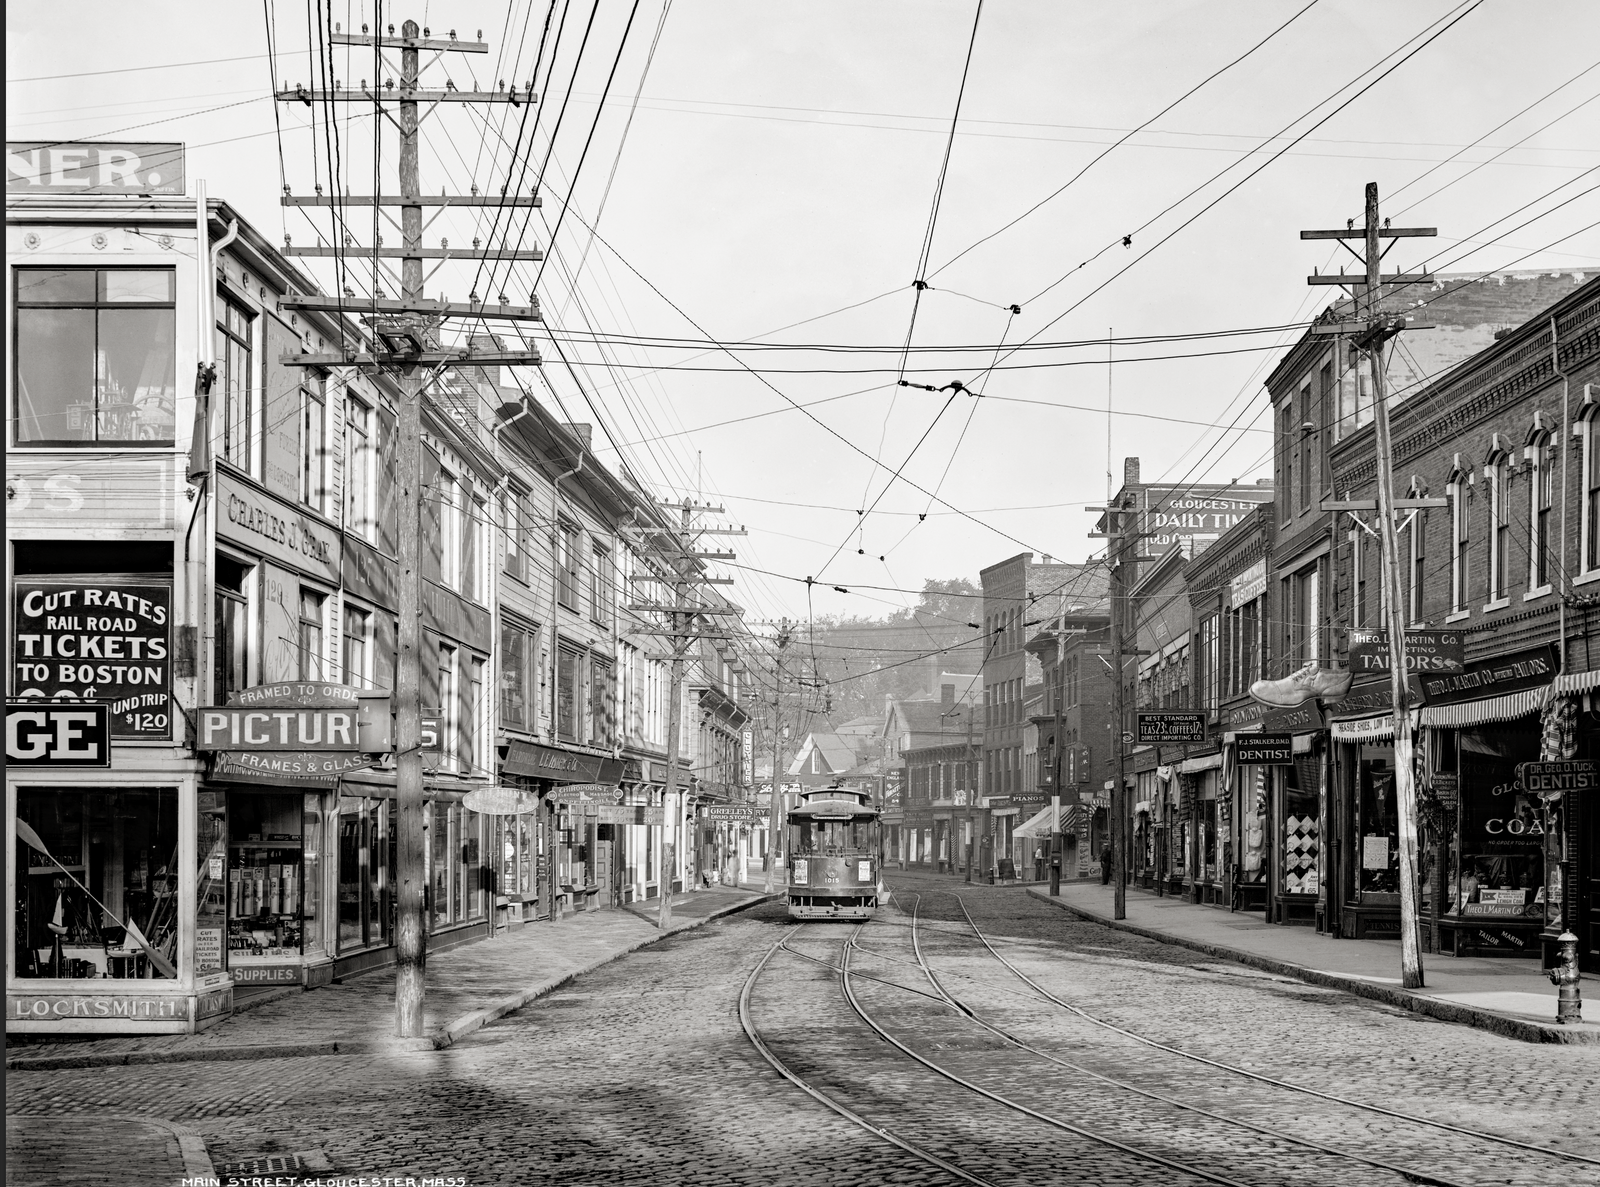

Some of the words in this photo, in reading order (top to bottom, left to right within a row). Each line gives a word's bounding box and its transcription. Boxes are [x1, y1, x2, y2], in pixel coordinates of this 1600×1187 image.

[227, 493, 286, 546] CHARLES
[301, 528, 331, 565] GRAY.
[1155, 513, 1208, 528] DAILY
[1211, 513, 1247, 529] TIM
[23, 589, 77, 617] CUT
[84, 589, 167, 625] RATES
[46, 615, 82, 631] RAIL
[86, 617, 137, 632] ROAD
[18, 634, 167, 660] TICKETS
[1353, 633, 1382, 644] THEO.
[1404, 636, 1435, 644] ARTIN
[1441, 634, 1459, 645] CO.
[1360, 654, 1444, 670] TAIORS
[17, 663, 50, 682] TO
[59, 664, 163, 685] BOSTON
[1427, 680, 1448, 696] THEO.
[1453, 671, 1482, 691] MARTIN
[1481, 669, 1495, 685] CO.
[1512, 657, 1550, 679] TAILORS.
[240, 685, 291, 704] FRAMED
[297, 684, 315, 696] TO
[322, 686, 358, 702] ORDE
[112, 696, 139, 715] UND
[140, 693, 168, 707] TRIP
[125, 713, 168, 731] $1.20
[204, 712, 359, 745] PICTUR
[1140, 725, 1155, 735] TEAS
[1169, 725, 1193, 735] COFFEES
[1239, 749, 1290, 760] DENTIST.
[241, 753, 301, 773] FRAMES
[306, 762, 318, 774] &
[322, 753, 373, 771] GLASS
[1530, 764, 1544, 774] DR.
[1544, 763, 1564, 774] GEO.
[1563, 763, 1572, 773] O.
[1571, 762, 1597, 772] TUCK.
[558, 785, 609, 793] CHIROPODIST.
[1529, 772, 1599, 790] DENTIST.
[1484, 818, 1546, 835] COA
[1467, 904, 1482, 914] THEO
[1483, 904, 1489, 914] L
[1488, 904, 1511, 915] MARTIN
[1511, 905, 1522, 915] CO
[1479, 929, 1499, 946] TAILOR
[1501, 930, 1524, 947] MARTIN
[234, 968, 297, 981] SUPPLIES.
[16, 999, 182, 1017] LOCKSMITH.
